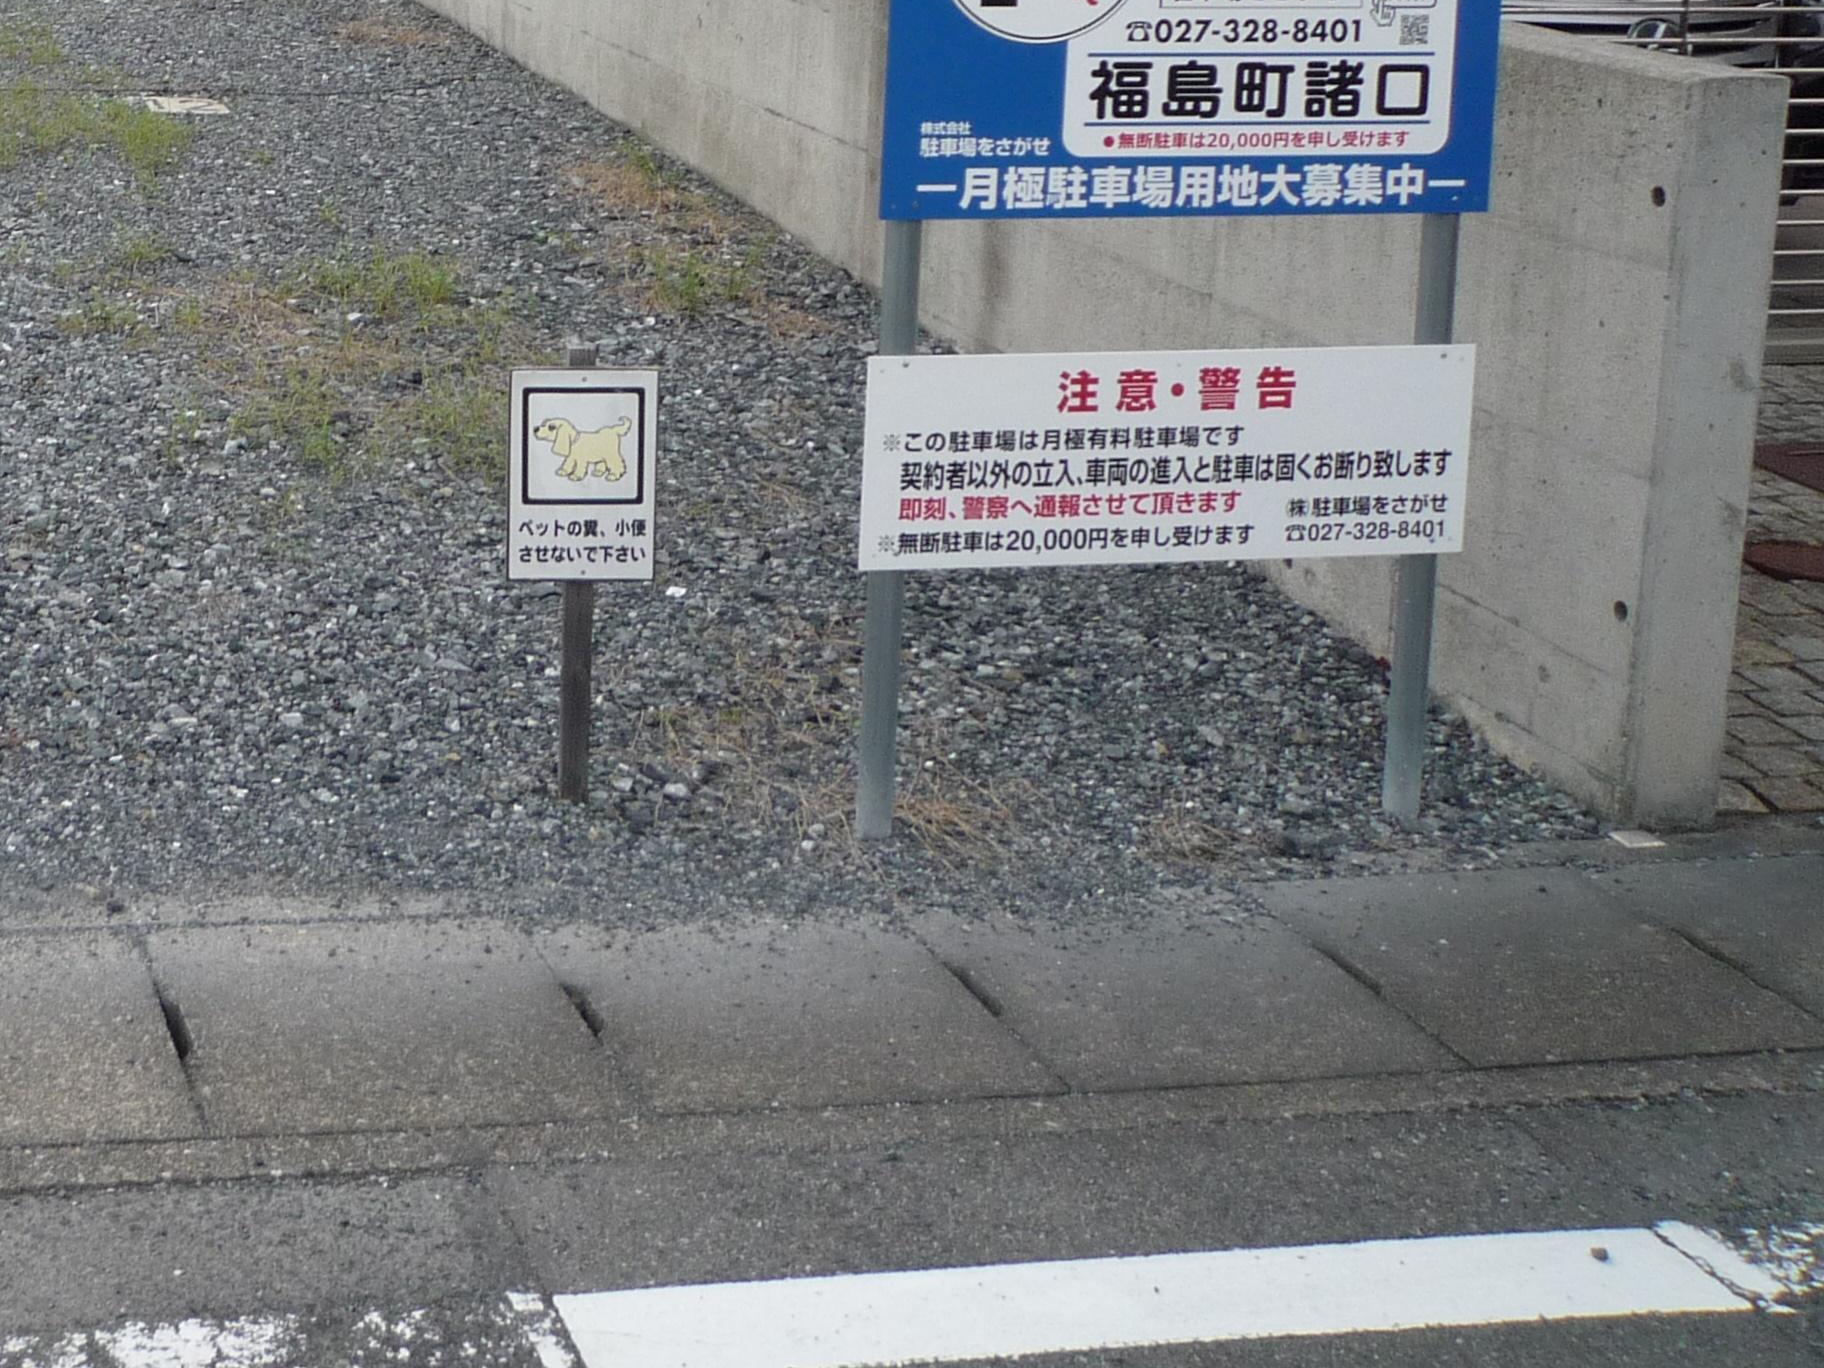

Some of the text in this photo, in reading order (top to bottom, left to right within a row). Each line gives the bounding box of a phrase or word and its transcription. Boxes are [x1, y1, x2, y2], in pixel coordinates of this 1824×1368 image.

[1154, 18, 1362, 43] 027-328-8401
[1090, 59, 1430, 120] 福島町諸口
[920, 136, 1052, 157] 駐車場をさがせ
[1057, 365, 1298, 414] 注意・警告
[898, 490, 1243, 521] 即刻、警察へ通報させて頂きます
[1307, 519, 1446, 543] 027-328-8401
[518, 544, 646, 563] させないで下さい
